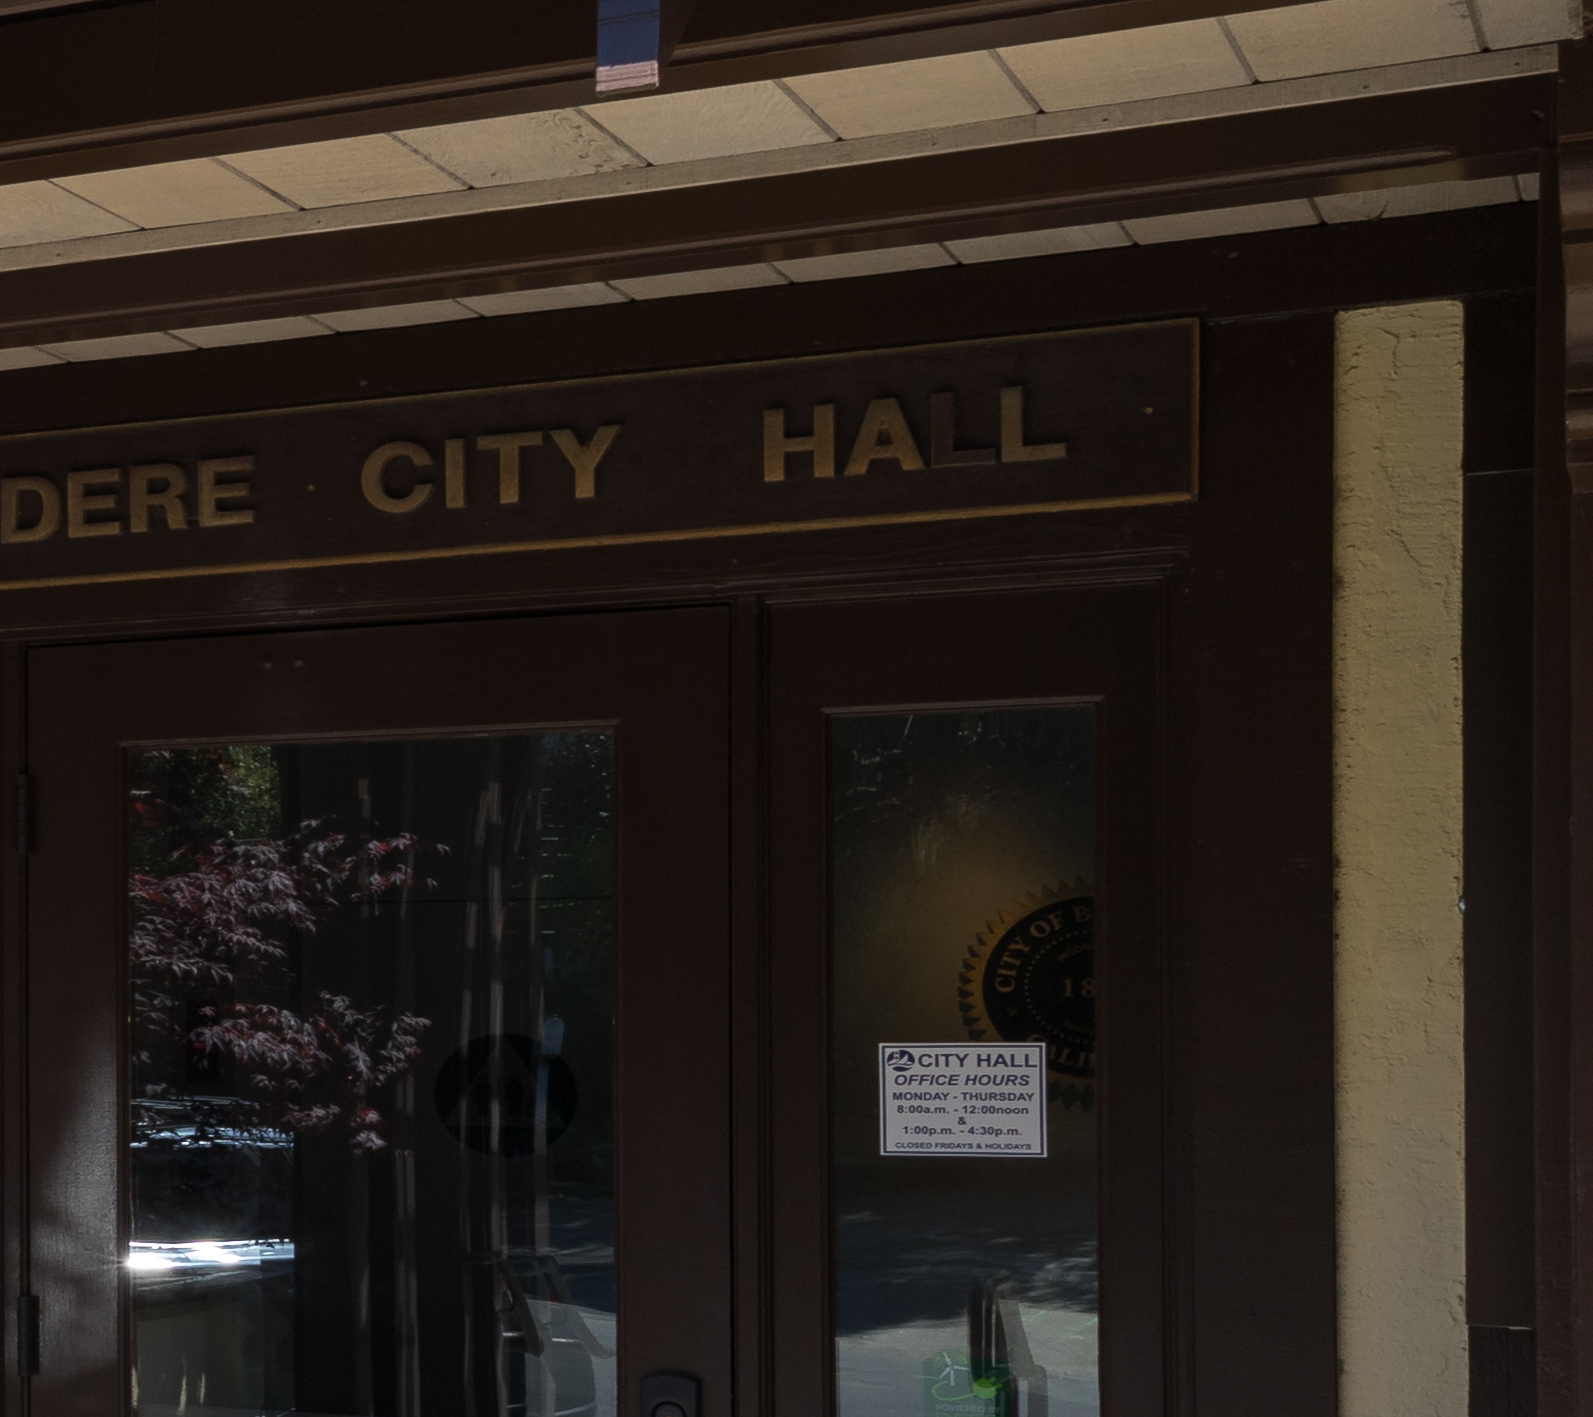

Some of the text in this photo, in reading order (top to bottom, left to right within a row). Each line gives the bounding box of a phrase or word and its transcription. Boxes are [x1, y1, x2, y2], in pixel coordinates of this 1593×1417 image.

[360, 423, 622, 515] CITY
[762, 384, 1067, 485] HALL
[995, 910, 1065, 994] CITY OF
[917, 1053, 970, 1068] CITY
[976, 1053, 1038, 1069] HALL
[893, 1073, 1031, 1087] OFFICE HOURS
[892, 1091, 951, 1102] MONDAY
[960, 1092, 1035, 1102] THURSDAY
[896, 1104, 950, 1115] 8:00a.m.
[961, 1104, 1029, 1115] 12:00noon
[957, 1116, 968, 1126] &
[902, 1125, 956, 1137] 1:00p.m.
[967, 1125, 1023, 1138] 4:30p.m.
[894, 1141, 933, 1150] CLOSED
[934, 1141, 974, 1150] FRIDAYS
[985, 1142, 1033, 1151] HOLIDAYS
[935, 1404, 986, 1413] POWERED
